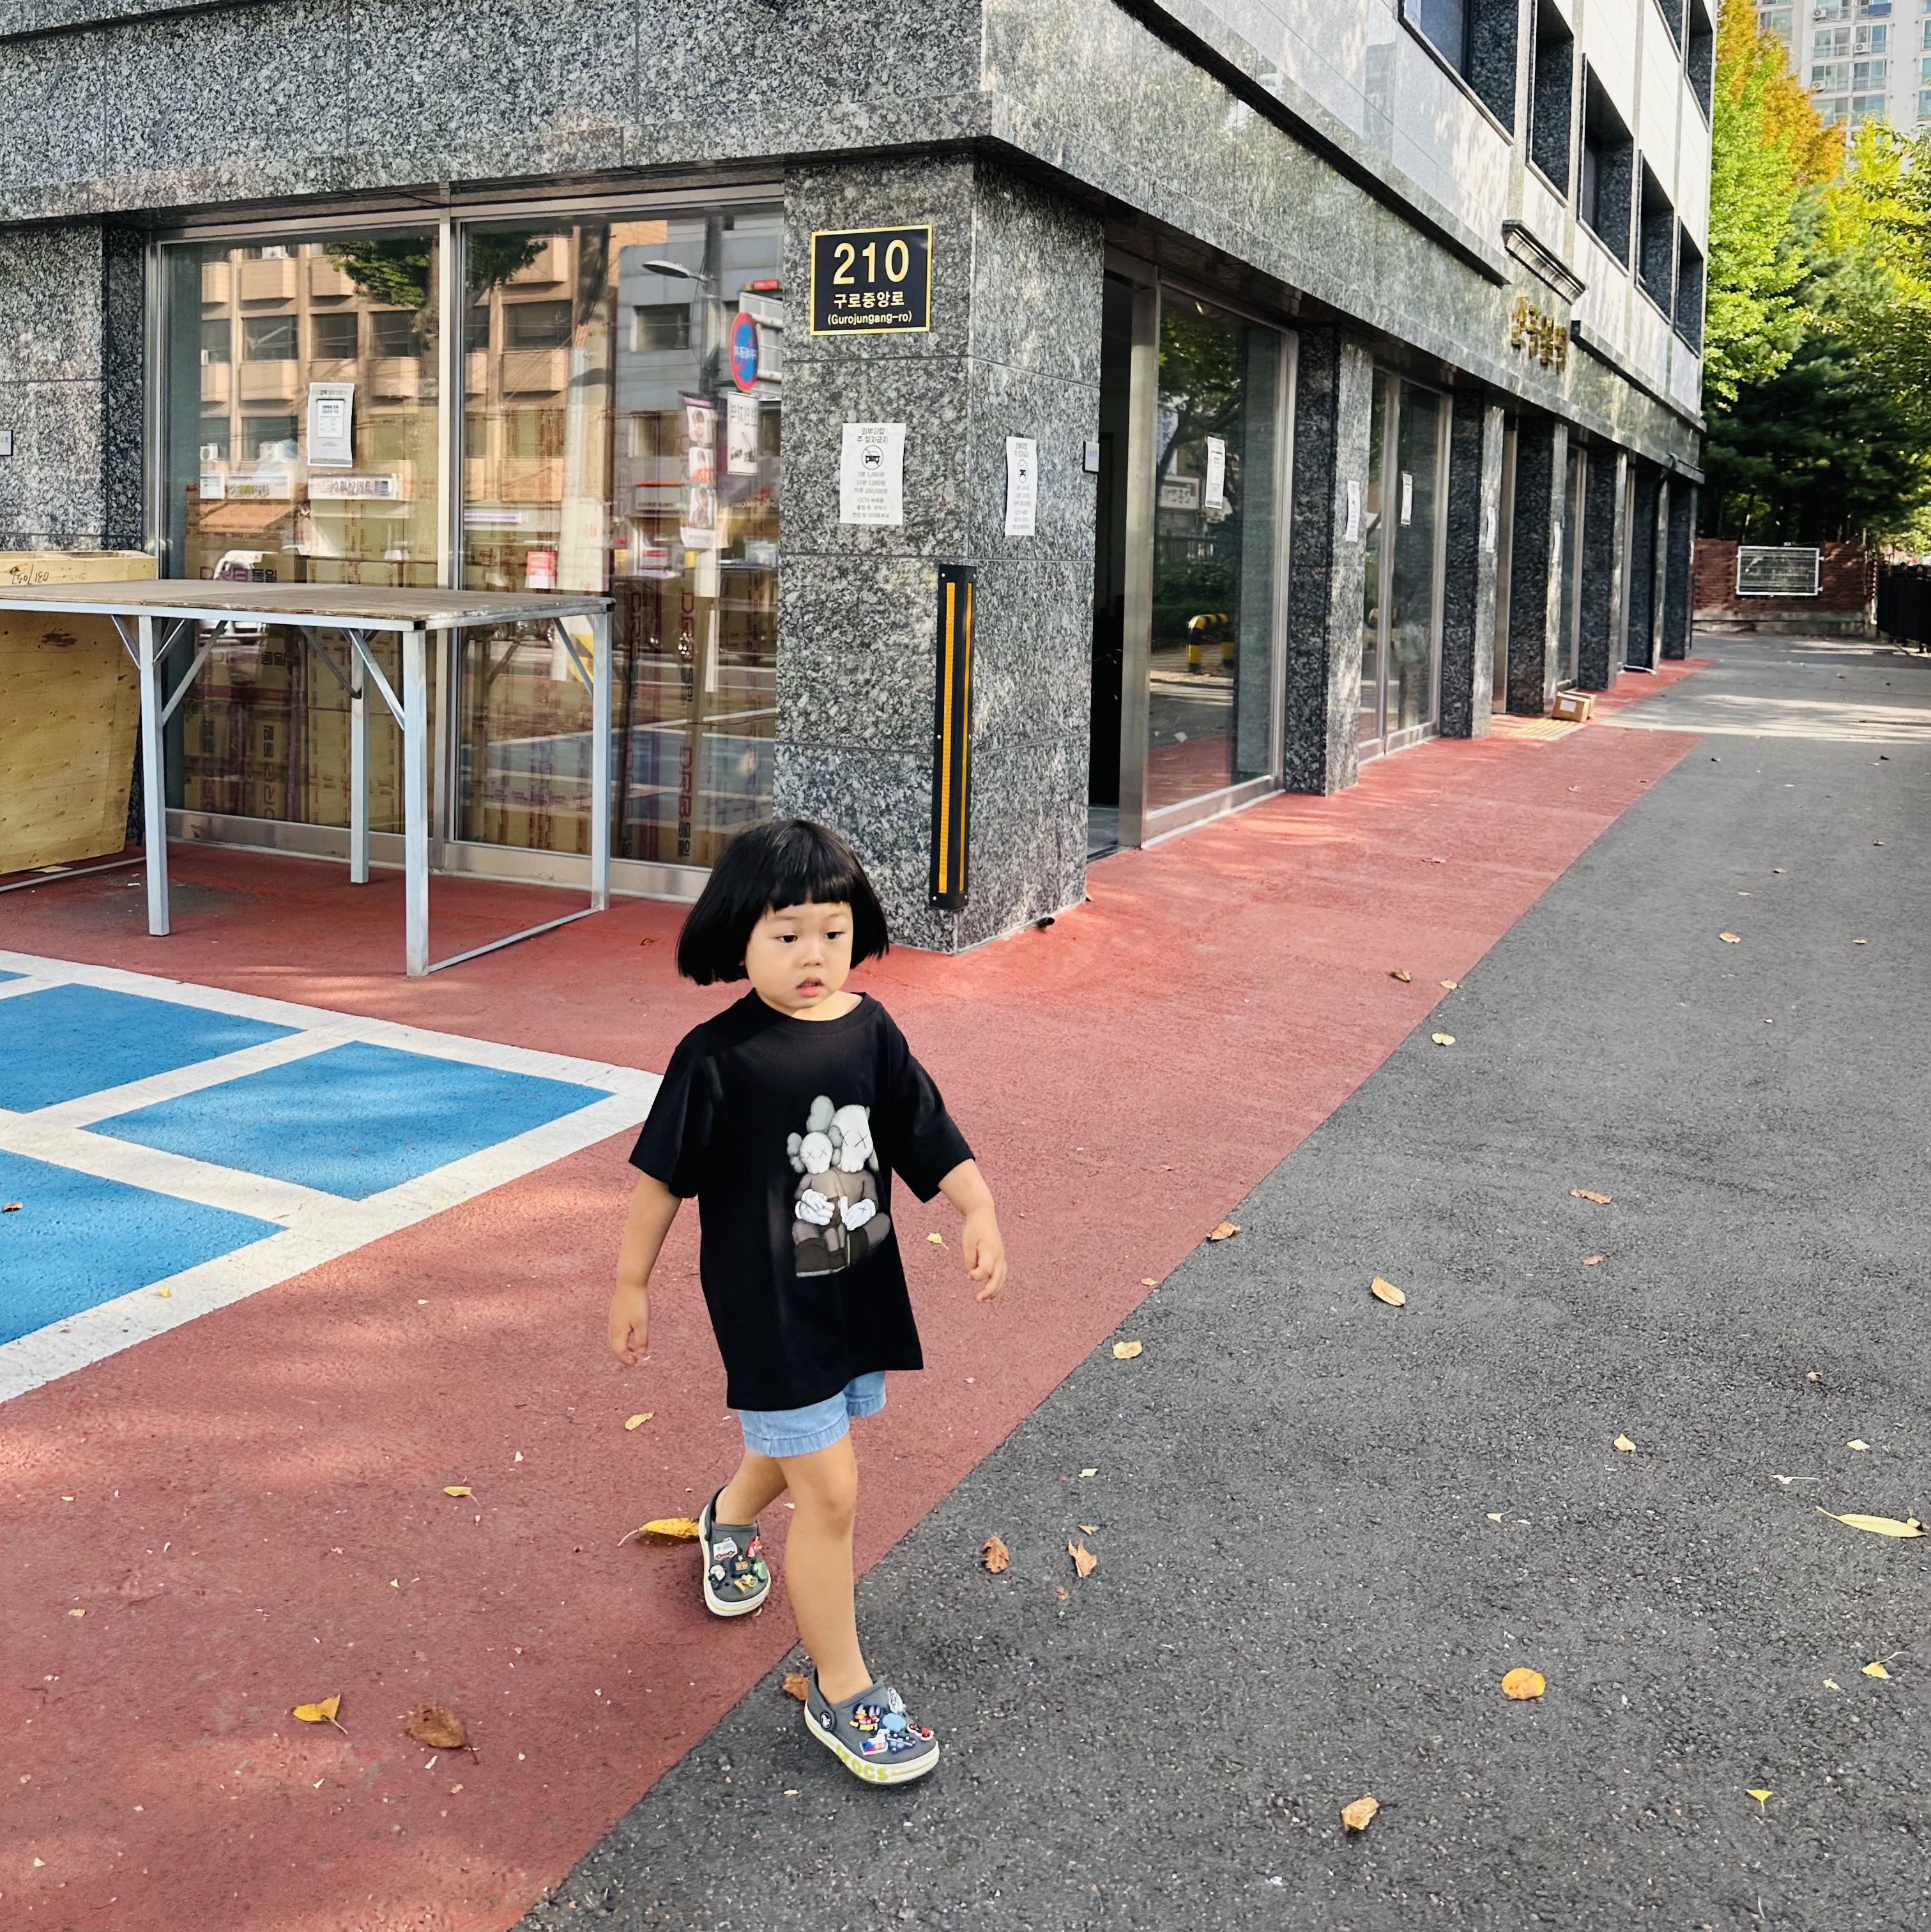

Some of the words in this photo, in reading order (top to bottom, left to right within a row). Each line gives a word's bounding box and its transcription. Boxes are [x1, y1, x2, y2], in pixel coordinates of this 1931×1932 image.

[833, 239, 909, 285] 210
[834, 291, 904, 309] 구로중앙로
[827, 310, 912, 326] (Gurojungang-ro)
